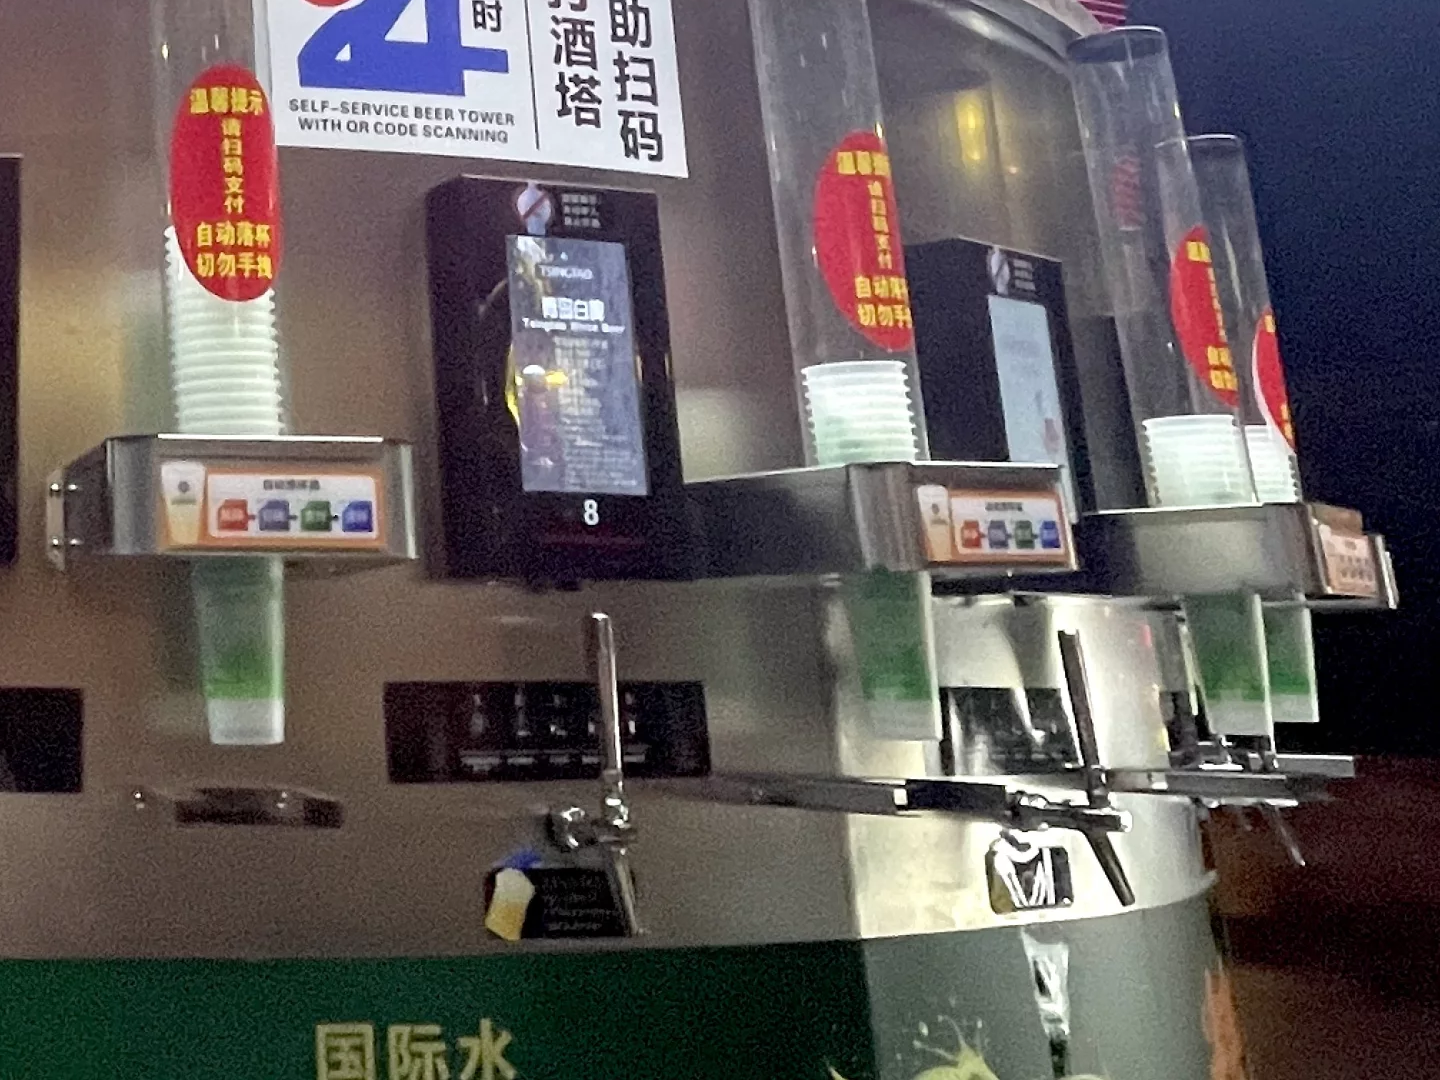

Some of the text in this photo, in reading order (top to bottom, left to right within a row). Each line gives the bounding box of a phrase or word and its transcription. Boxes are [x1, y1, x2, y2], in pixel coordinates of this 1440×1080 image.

[288, 98, 516, 127] SELF-SERVICE BEER TOWER
[298, 116, 509, 144] WITH QR CODE SCANNING
[583, 498, 600, 526] 8
[315, 1018, 519, 1080] 国际水
